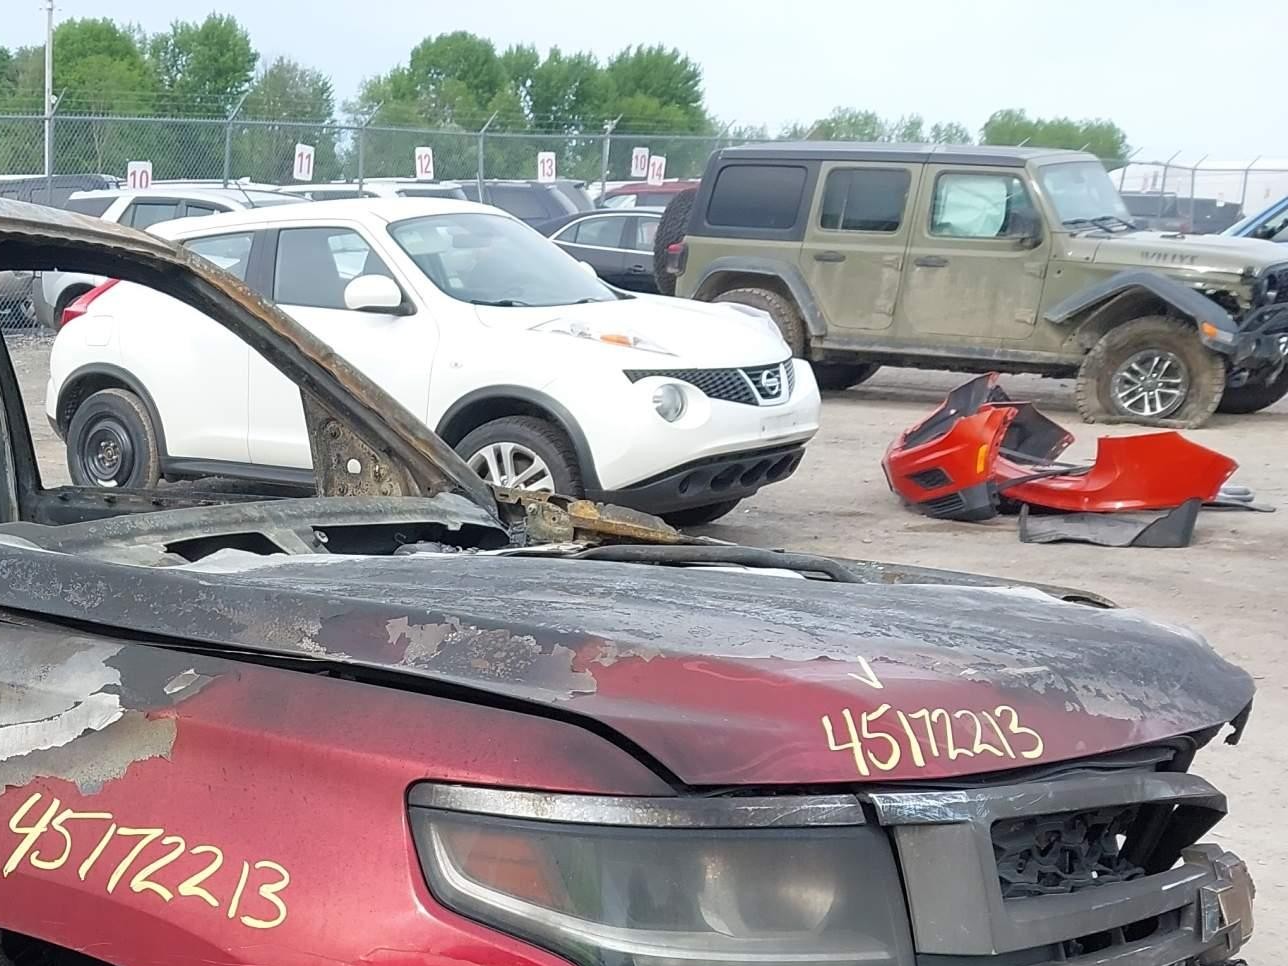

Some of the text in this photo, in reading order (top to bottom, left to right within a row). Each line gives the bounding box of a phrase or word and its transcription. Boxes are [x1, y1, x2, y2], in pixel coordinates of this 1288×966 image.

[297, 151, 312, 174] 11
[417, 153, 432, 174] 12
[539, 157, 554, 177] 13
[633, 154, 646, 171] 10
[650, 160, 663, 180] 14
[130, 169, 149, 189] 10
[821, 703, 1044, 776] 45172213
[3, 792, 290, 929] 45172213
